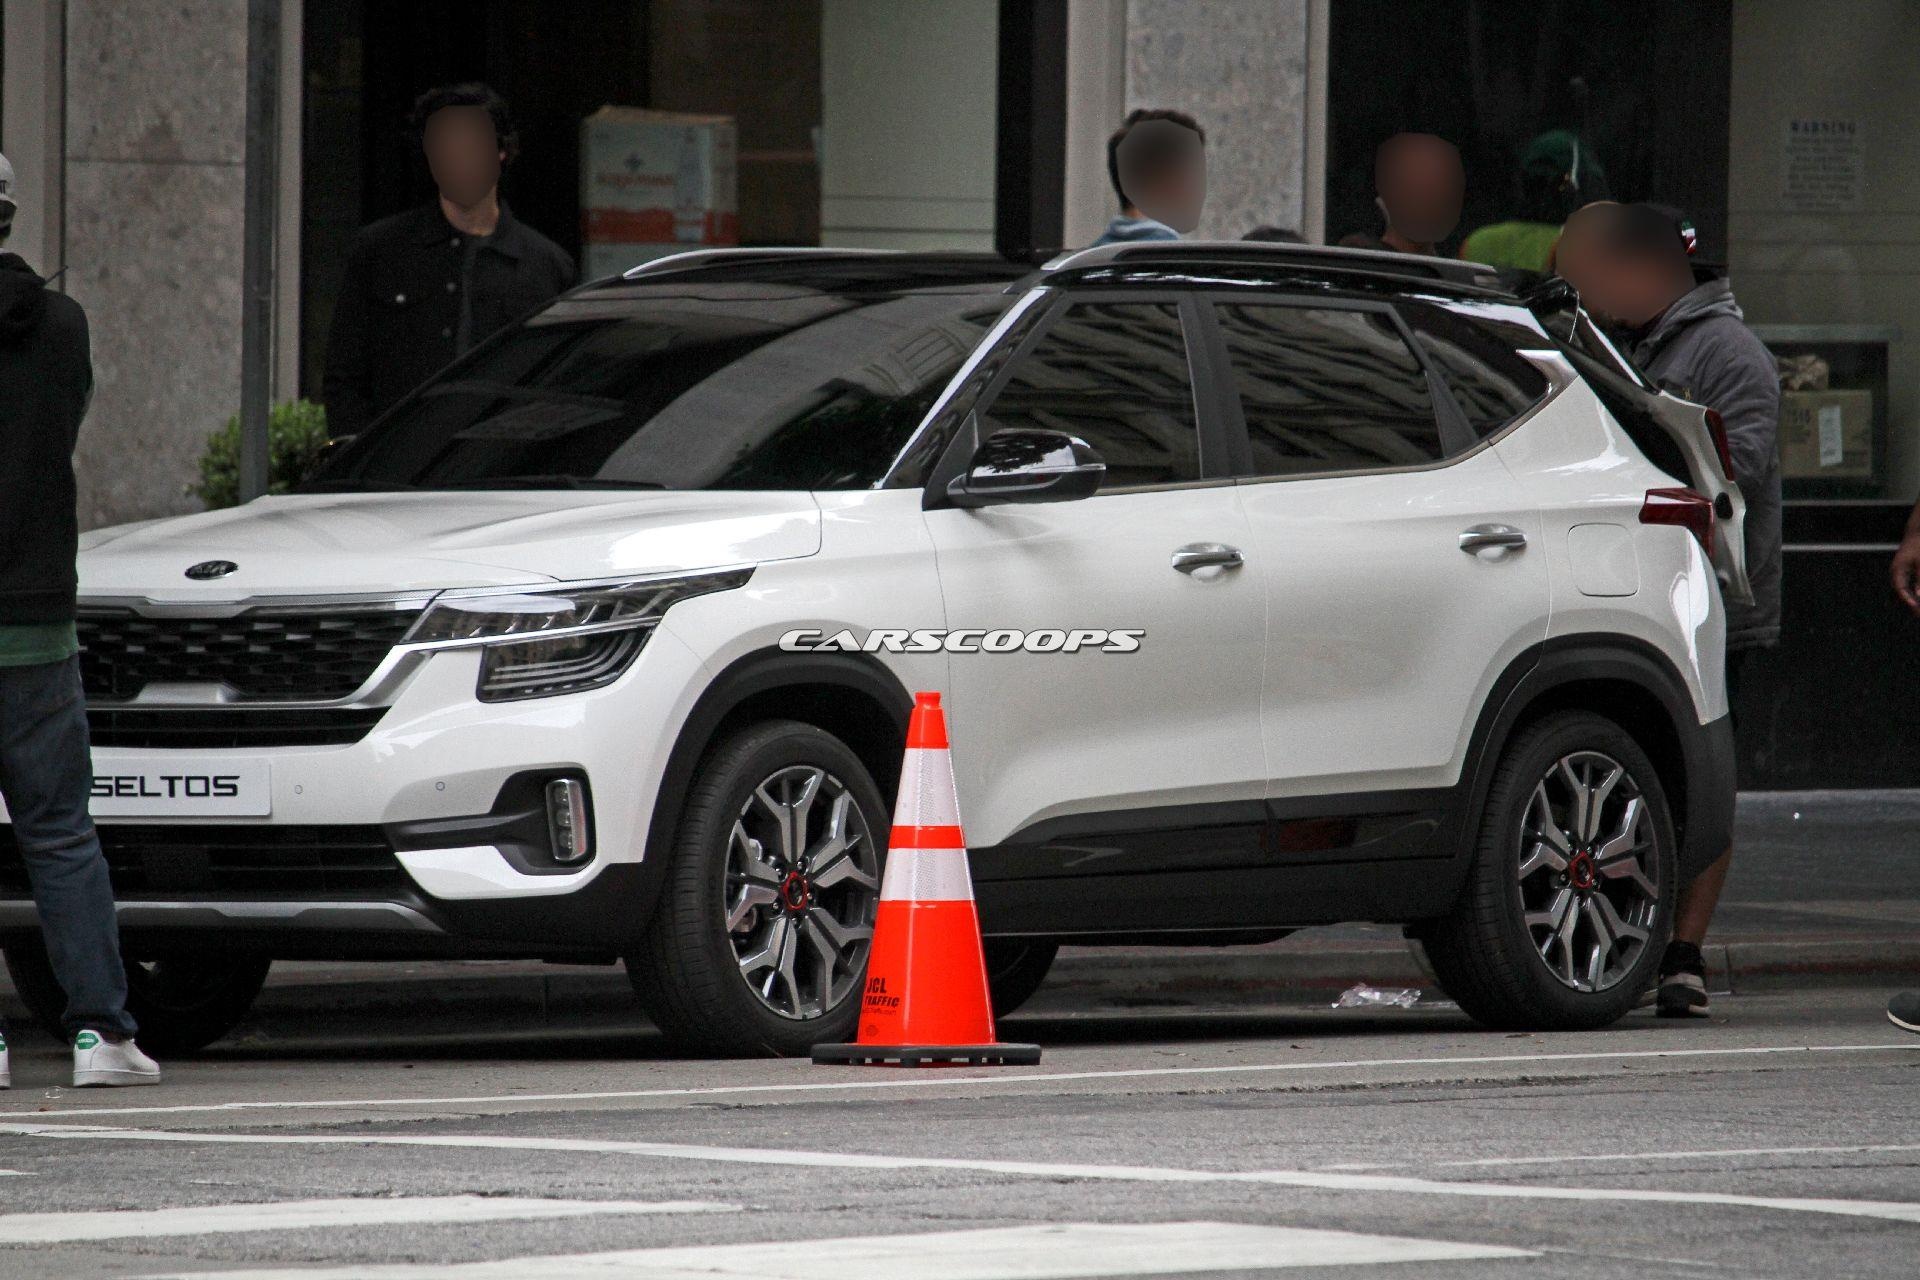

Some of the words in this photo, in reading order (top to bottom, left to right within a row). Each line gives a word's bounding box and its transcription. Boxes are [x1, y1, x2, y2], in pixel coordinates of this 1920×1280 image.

[1790, 121, 1856, 134] WARNING
[91, 775, 240, 798] SELTOS
[866, 977, 887, 993] JCL
[865, 995, 900, 1008] TRAFFIC
